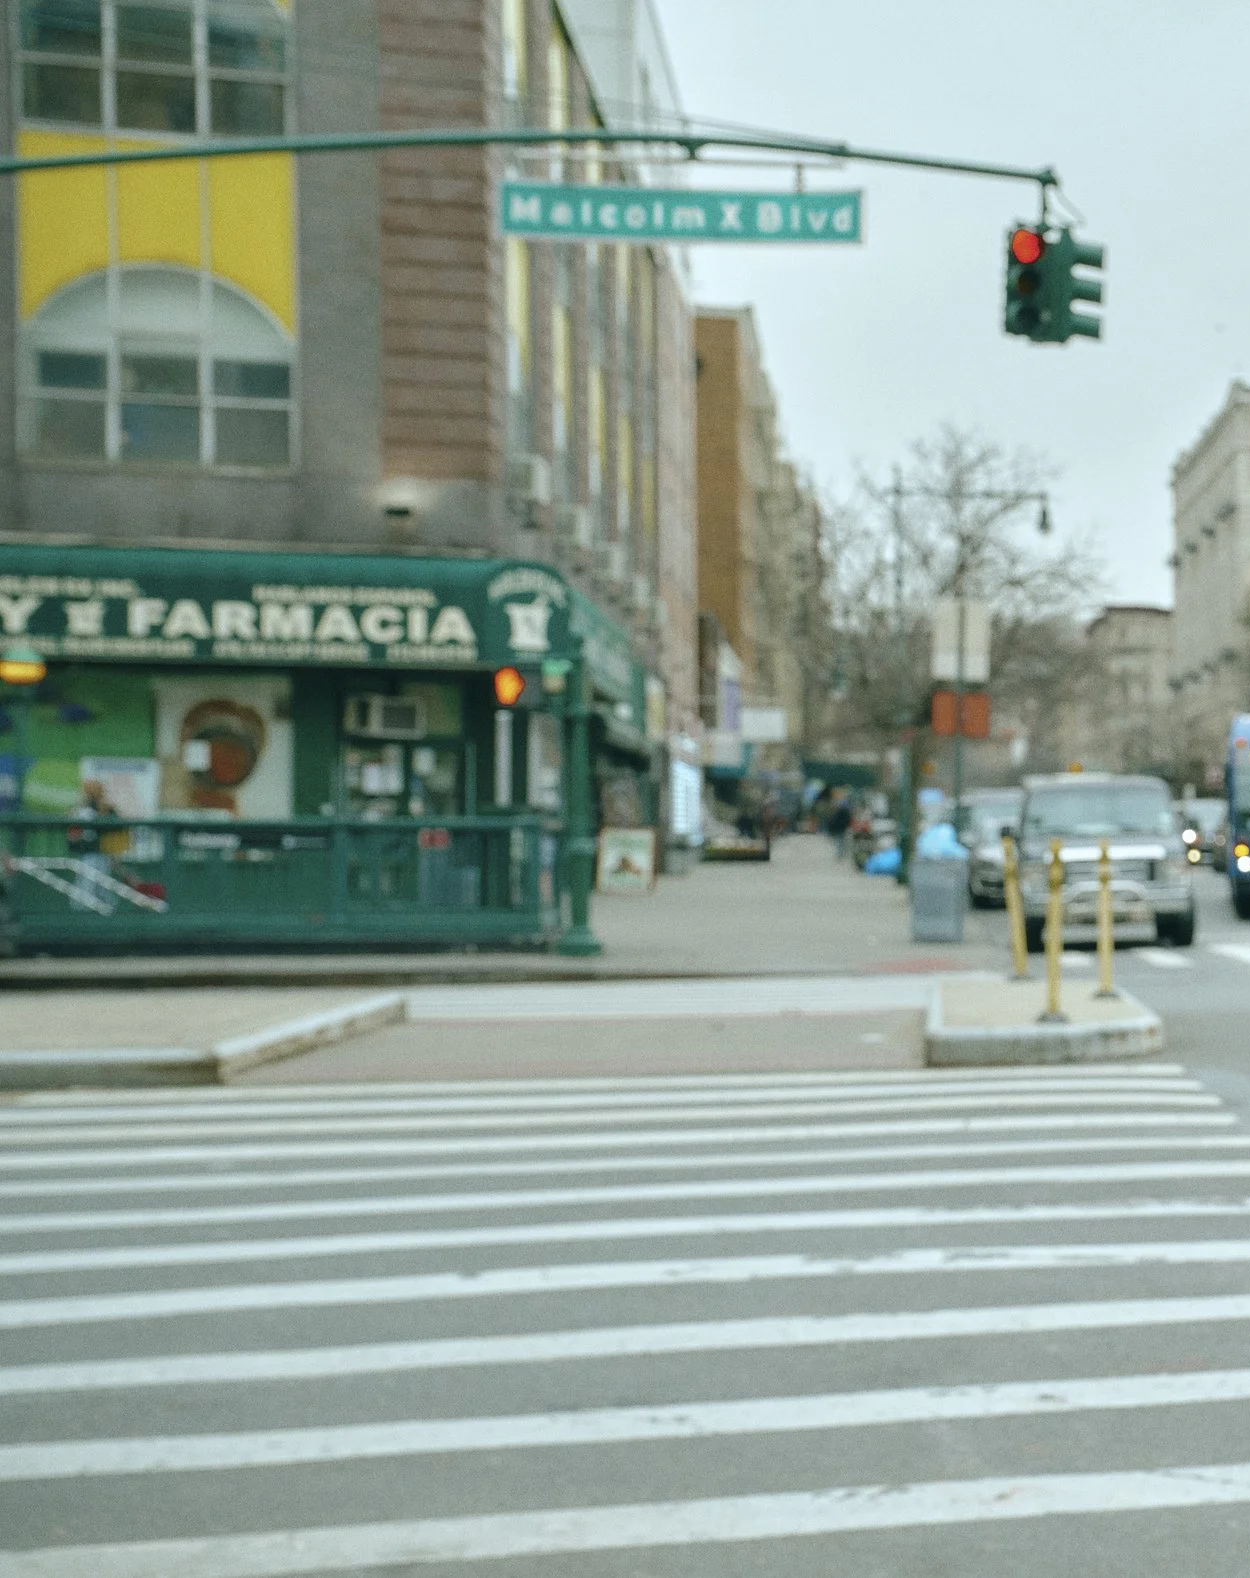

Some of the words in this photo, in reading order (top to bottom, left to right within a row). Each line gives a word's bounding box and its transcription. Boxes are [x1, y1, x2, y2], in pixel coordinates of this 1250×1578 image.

[509, 193, 706, 230] Malcolm
[719, 201, 743, 231] X
[756, 202, 853, 234] Blvd
[128, 598, 477, 645] FARMACIA
